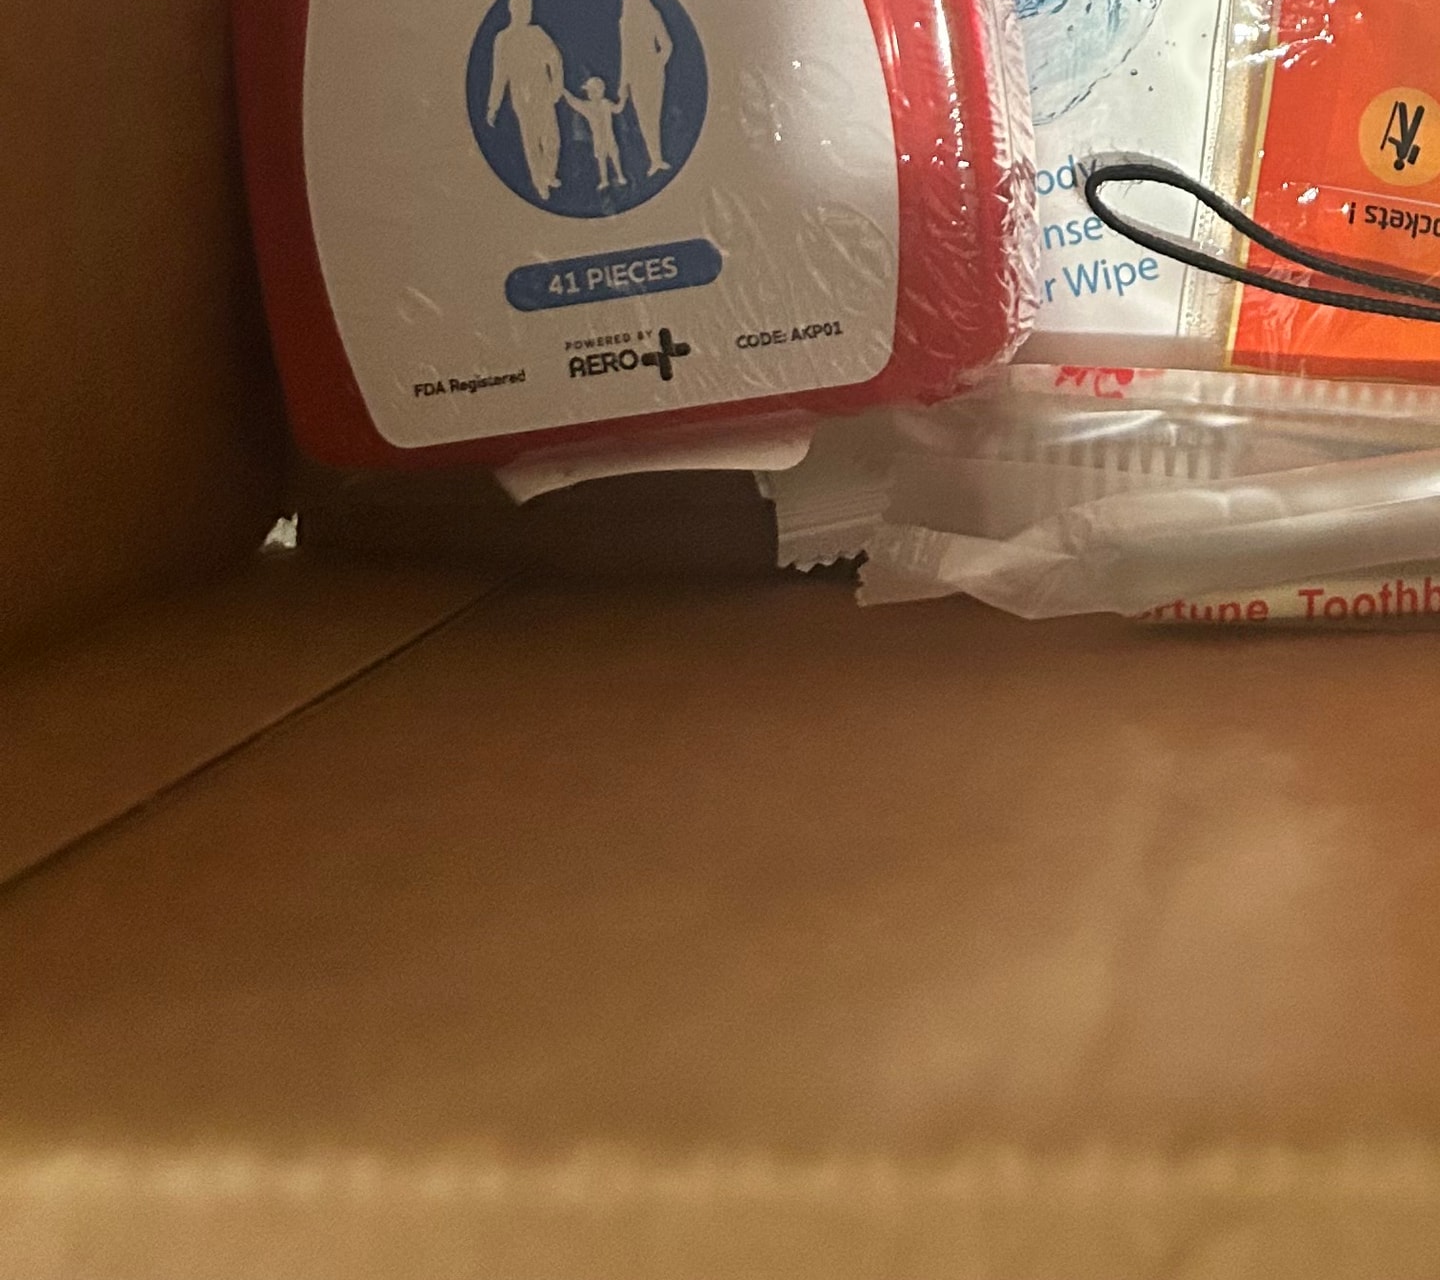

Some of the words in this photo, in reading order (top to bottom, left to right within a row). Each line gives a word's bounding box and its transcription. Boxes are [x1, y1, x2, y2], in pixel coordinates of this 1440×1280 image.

[547, 272, 581, 297] 41
[586, 255, 680, 293] PIECES
[1063, 254, 1160, 300] Wipe
[734, 328, 787, 350] CODE:
[569, 347, 640, 379] AERO
[413, 379, 447, 399] FDA
[449, 369, 527, 395] Registered
